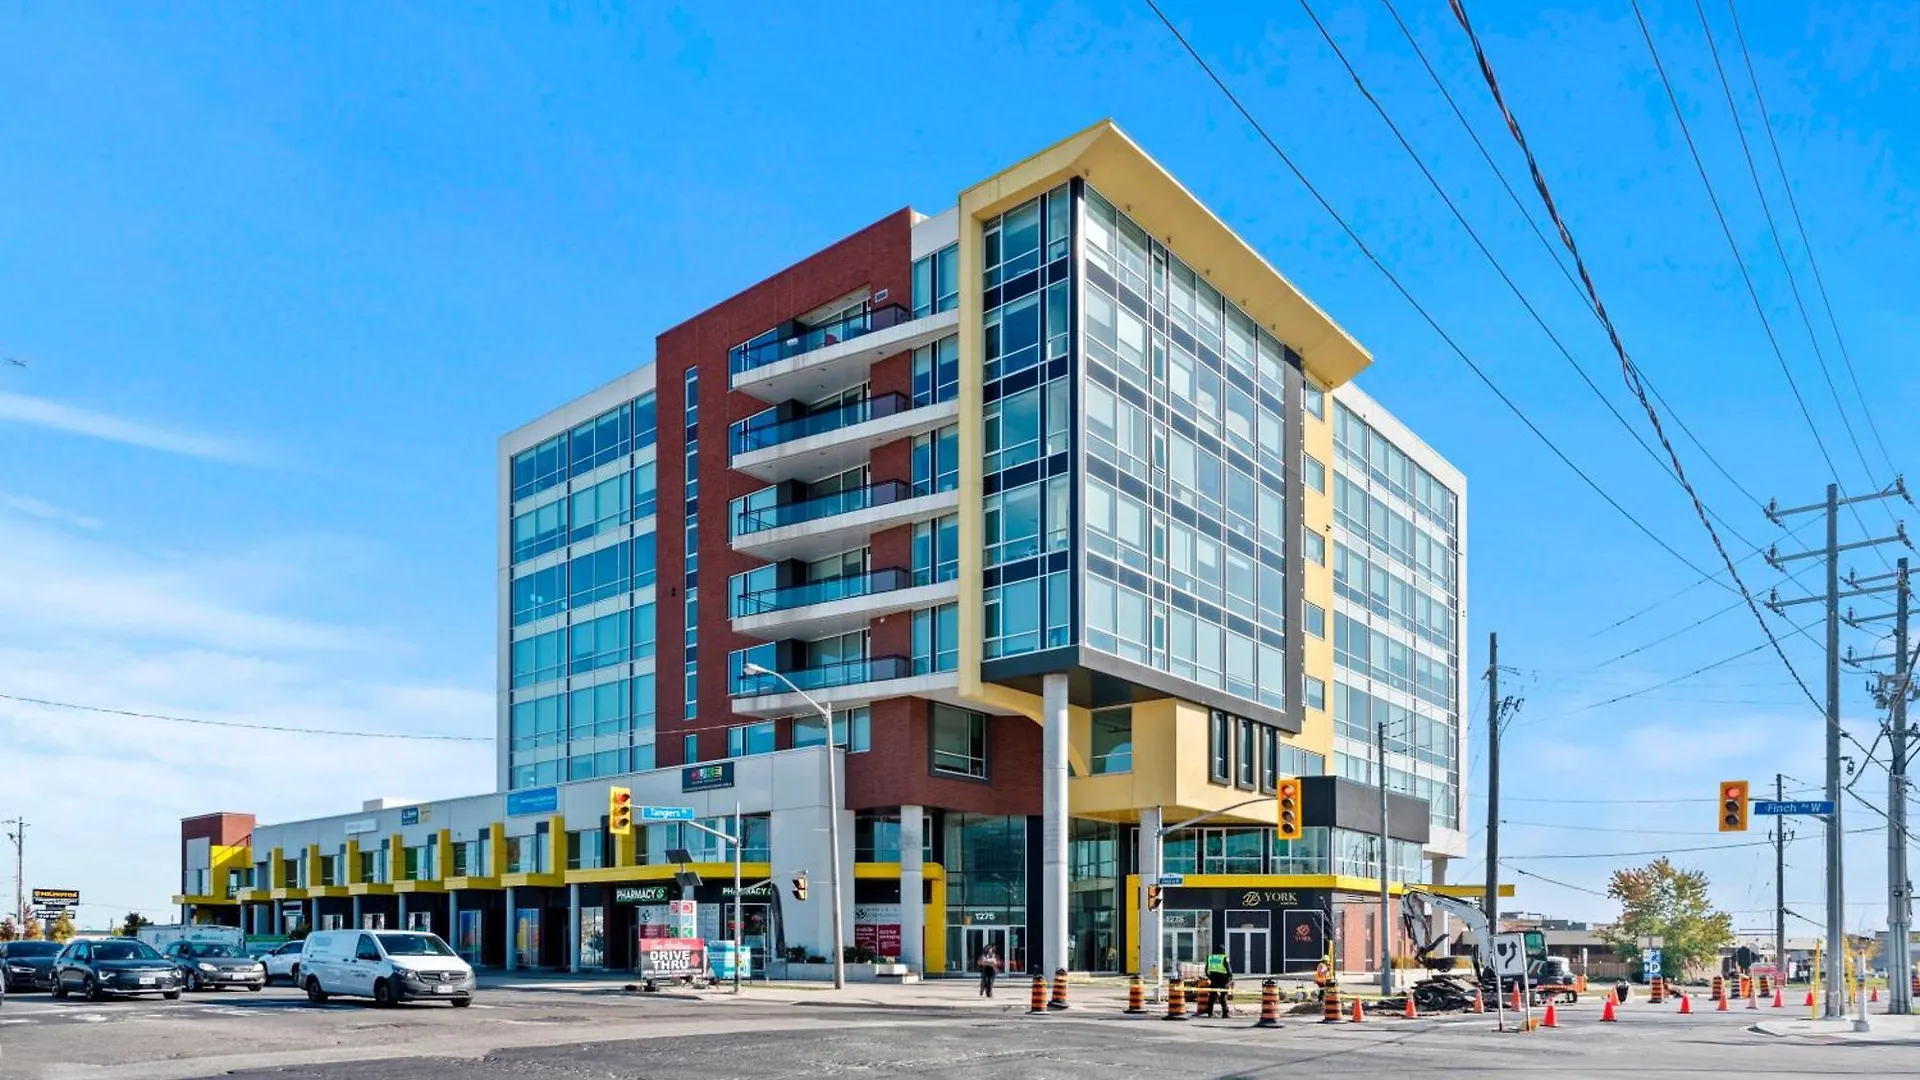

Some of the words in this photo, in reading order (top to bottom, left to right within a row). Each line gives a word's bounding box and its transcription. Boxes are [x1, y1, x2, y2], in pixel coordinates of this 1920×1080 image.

[1767, 803, 1797, 813] Finch
[1811, 803, 1821, 813] W
[616, 888, 656, 900] PHARMACY
[722, 887, 767, 896] PHACY
[1264, 892, 1298, 901] YORK
[975, 912, 996, 921] 1275
[650, 950, 690, 961] DRIVE
[652, 960, 689, 970] THRU
